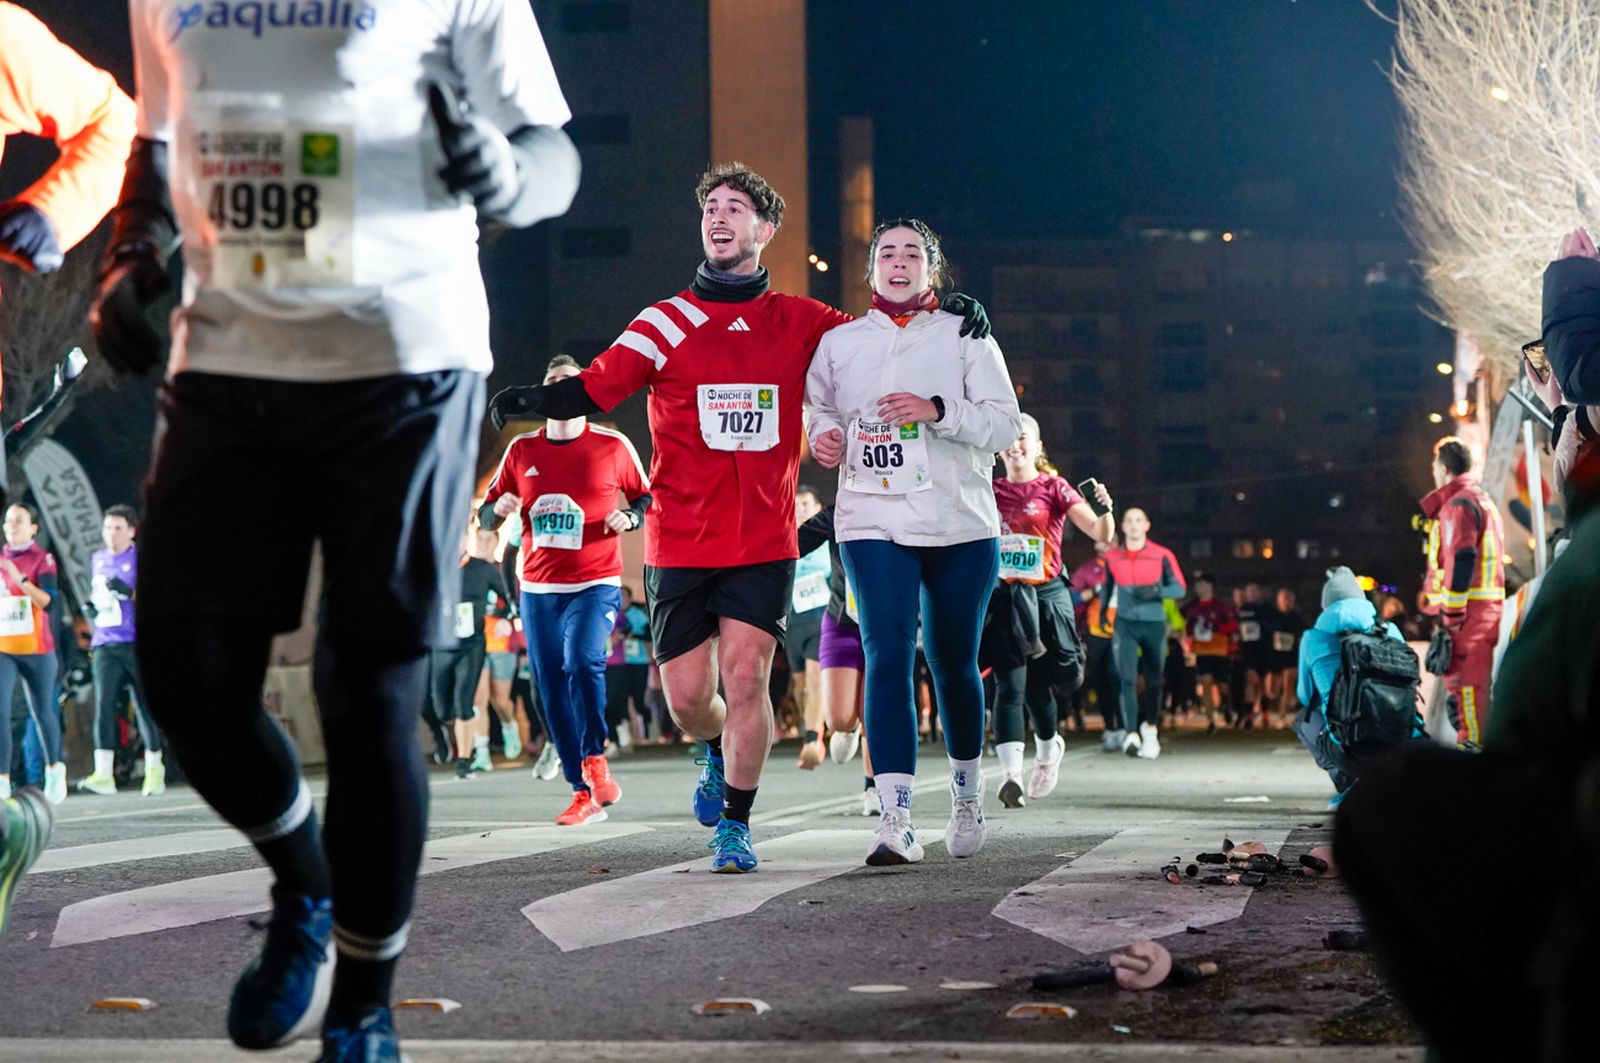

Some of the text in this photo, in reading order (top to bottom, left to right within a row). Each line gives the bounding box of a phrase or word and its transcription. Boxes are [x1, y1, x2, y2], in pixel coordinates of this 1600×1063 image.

[208, 182, 321, 231] 4998
[717, 391, 752, 400] NOCHE DE
[708, 402, 725, 410] SAN
[726, 399, 753, 410] ANTÓN
[718, 411, 763, 433] 7027
[880, 424, 891, 432] DE
[862, 443, 904, 469] 503
